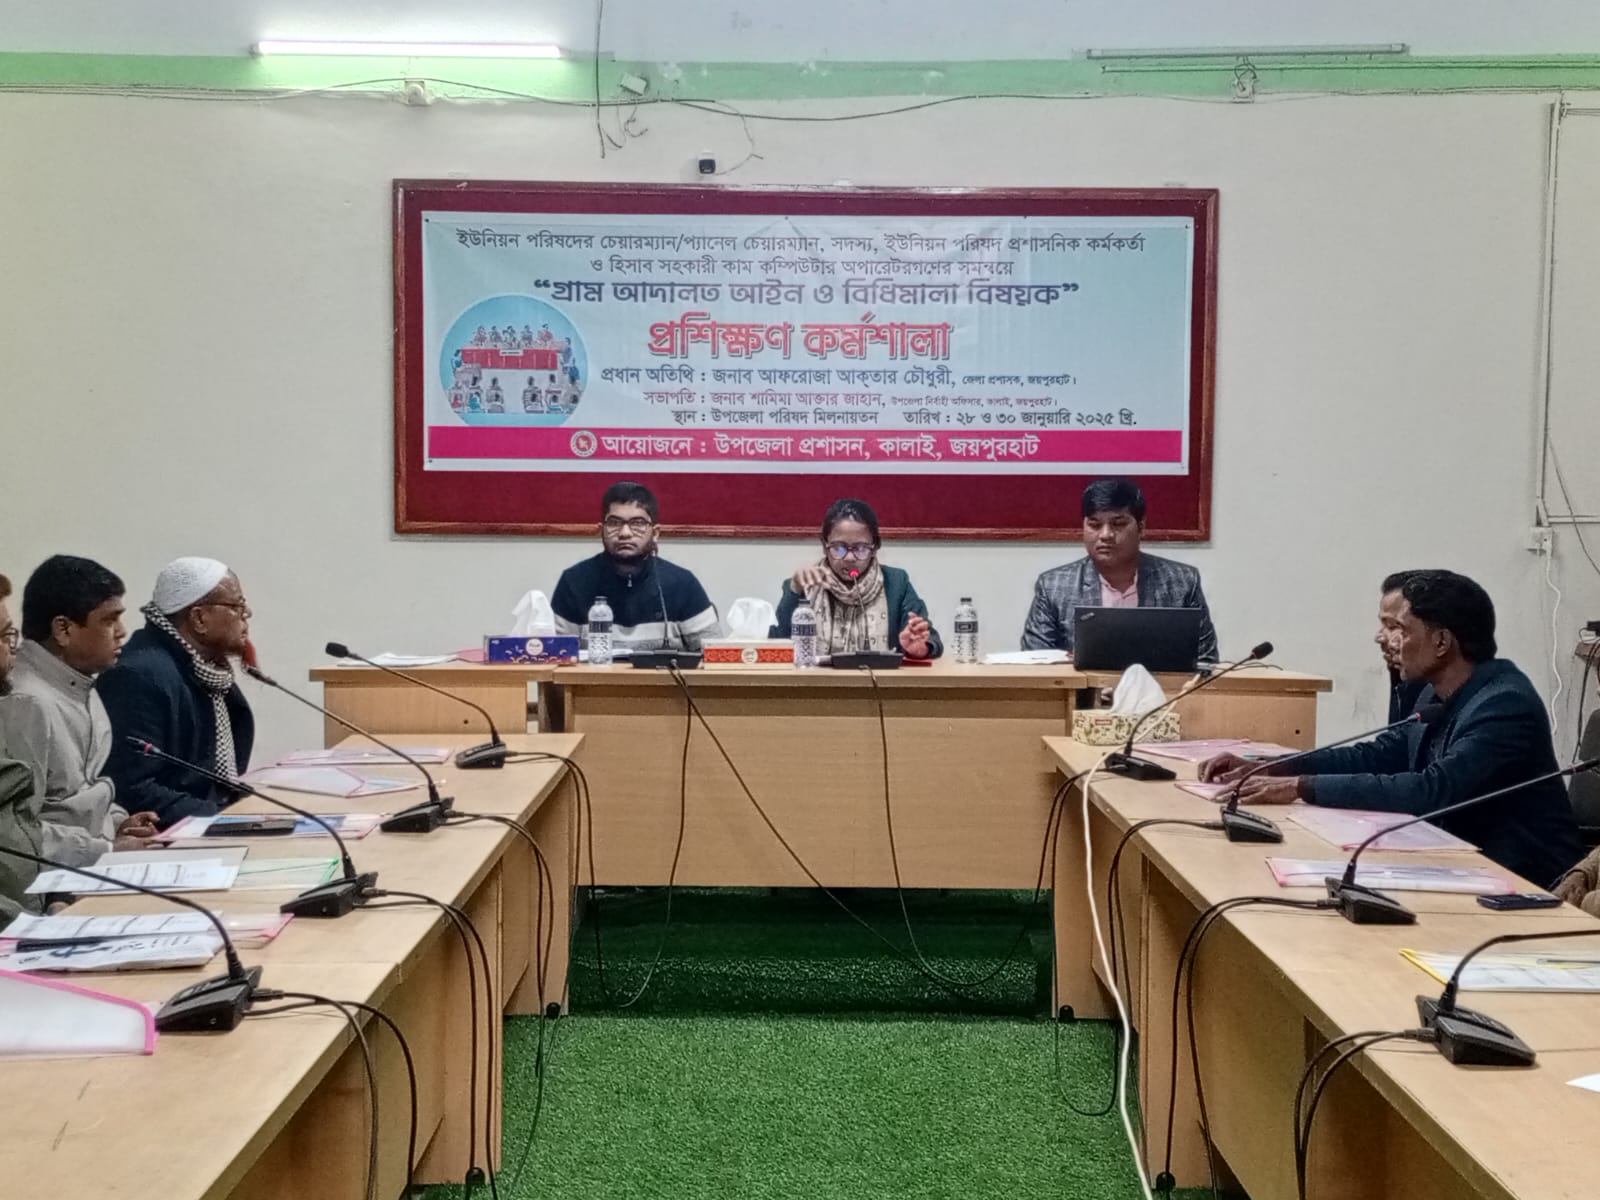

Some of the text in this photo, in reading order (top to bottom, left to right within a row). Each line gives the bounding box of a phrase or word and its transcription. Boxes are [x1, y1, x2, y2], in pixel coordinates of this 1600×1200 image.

[456, 228, 521, 248] ইউনিয়ন
[527, 229, 595, 249] পরিষদের
[743, 235, 825, 252] চেয়ারম্যান,
[831, 236, 878, 254] সদস্য,
[884, 233, 947, 252] ইউনিয়ন
[952, 234, 1002, 252] পরিষদ
[1007, 233, 1082, 252] প্রশাসনিক
[1085, 233, 1146, 252] কর্মকর্তা
[590, 258, 603, 271] ও
[609, 255, 653, 274] হিসাব
[659, 255, 717, 274] সহকারী
[722, 260, 753, 275] কাম
[759, 256, 836, 275] কম্পিউটার
[841, 258, 954, 276] অপারেটরগণের
[612, 281, 722, 303] আদালত
[729, 279, 805, 305] আইন
[813, 285, 834, 304] ও
[842, 277, 960, 305] বিধিমালা
[647, 310, 954, 361] প্রশিক্ষণ কর্মশালা
[600, 367, 641, 384] প্রধান
[646, 364, 695, 384] অতিথি
[712, 369, 753, 385] জনাব
[758, 368, 832, 385] আফরোজা
[904, 365, 956, 389] চৌধুরী,
[961, 374, 985, 385] জেলা
[987, 374, 1024, 387] প্রশাসক,
[643, 388, 696, 405] সভাপতি
[709, 391, 745, 405] জনাব
[750, 388, 792, 406] শামিমা
[795, 392, 839, 407] আক্তার
[844, 392, 886, 409] জাহান,
[890, 396, 923, 407] উপজেলা
[672, 409, 696, 425] স্থান
[711, 407, 763, 424] উপজেলা
[769, 408, 810, 424] পরিষদ
[813, 408, 879, 424] মিলনায়তন
[903, 408, 941, 424] তারিখ
[956, 412, 976, 425] ২৮
[980, 412, 992, 423] ও
[995, 413, 1016, 424] ৩০
[1021, 408, 1072, 427] জানুয়ারি
[1075, 411, 1114, 426] ২০২৫
[600, 435, 693, 456] আয়োজনে
[714, 433, 793, 456] উপজেলা
[799, 436, 871, 460] প্রশাসন,
[877, 433, 943, 460] কালাই,
[950, 433, 1041, 460] জয়পুরহাট
